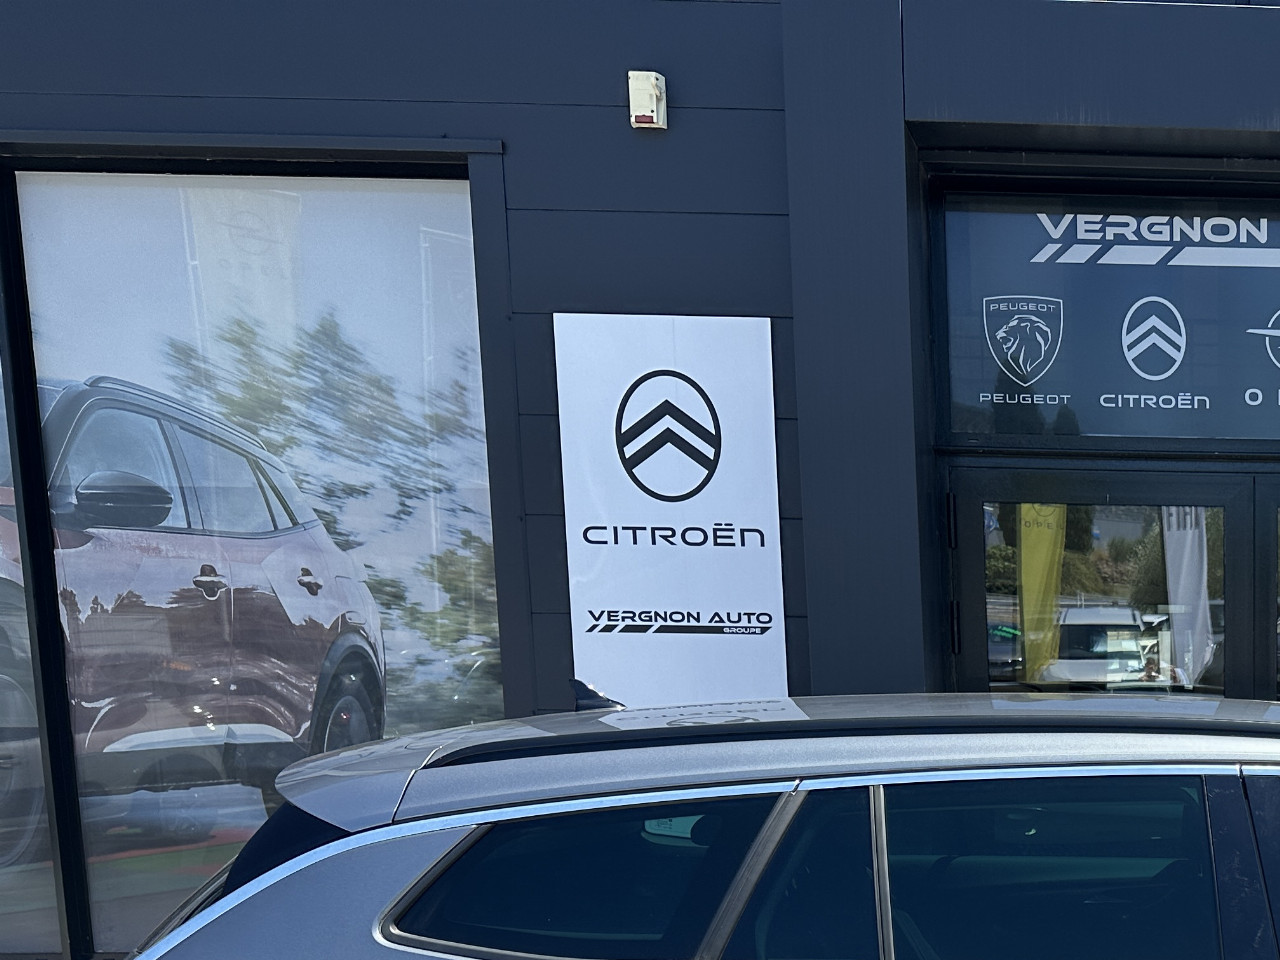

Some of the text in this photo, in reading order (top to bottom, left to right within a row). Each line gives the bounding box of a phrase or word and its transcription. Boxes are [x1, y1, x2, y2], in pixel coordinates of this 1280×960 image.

[1036, 213, 1268, 244] VERGNON
[990, 302, 1056, 312] PEUGEOT
[979, 393, 1071, 405] PEUGEOT
[588, 609, 773, 625] VERGNON AUTO
